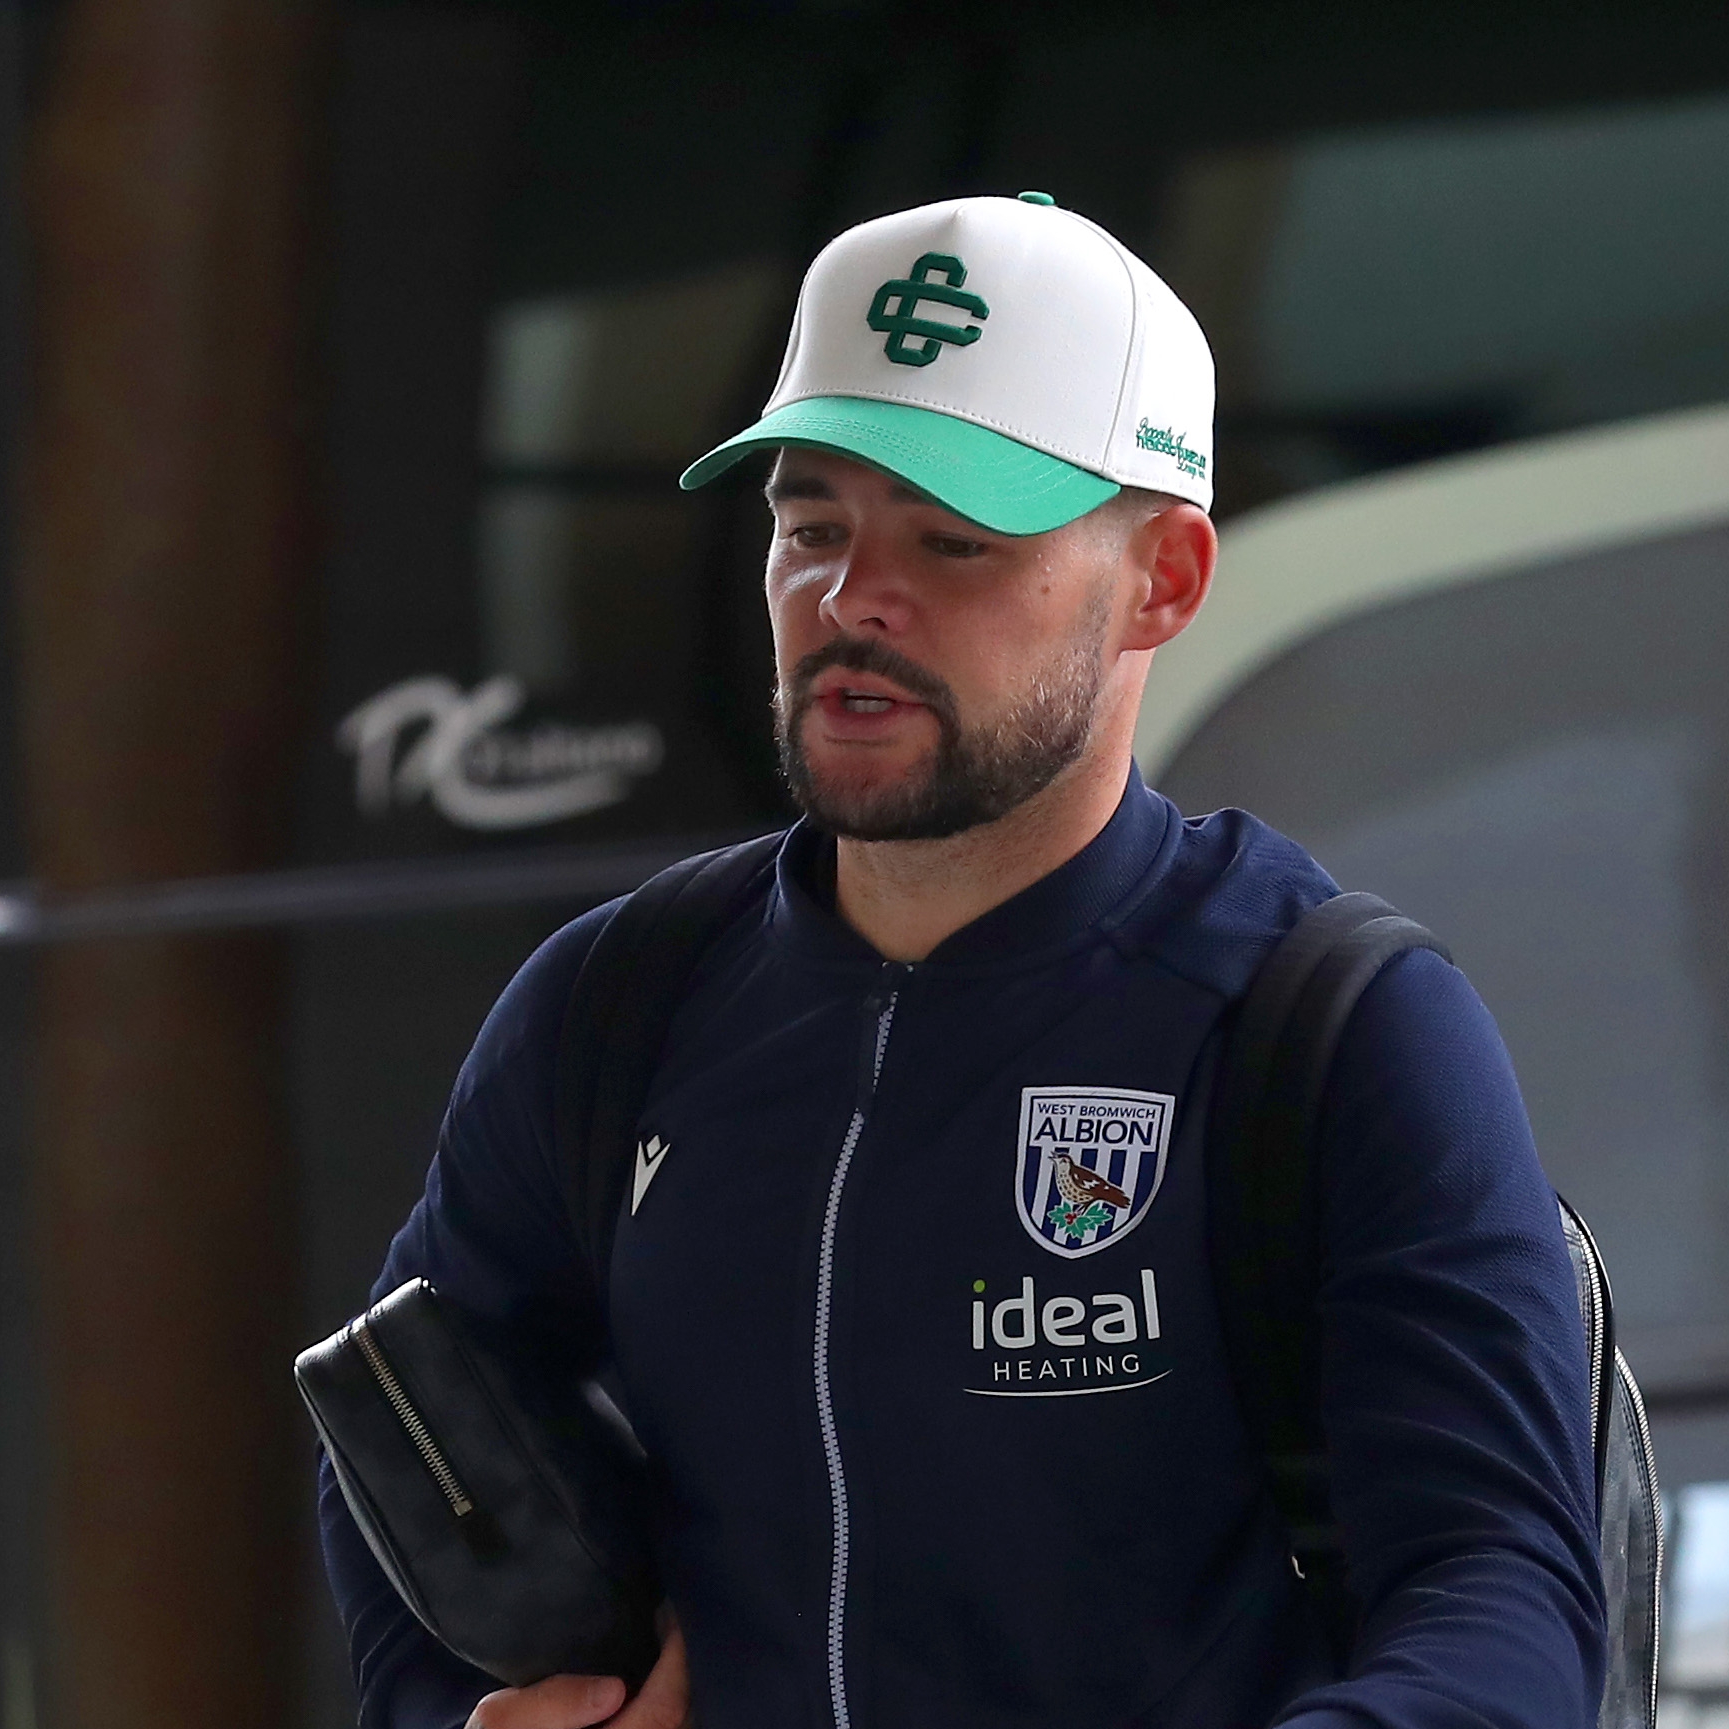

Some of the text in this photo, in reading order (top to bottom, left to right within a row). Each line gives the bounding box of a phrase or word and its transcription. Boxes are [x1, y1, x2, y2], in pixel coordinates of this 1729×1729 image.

[1038, 1102, 1157, 1120] WEST BROMWICH
[1033, 1118, 1155, 1147] ALBION
[972, 1268, 1161, 1351] ideal
[993, 1353, 1142, 1382] HEATING
